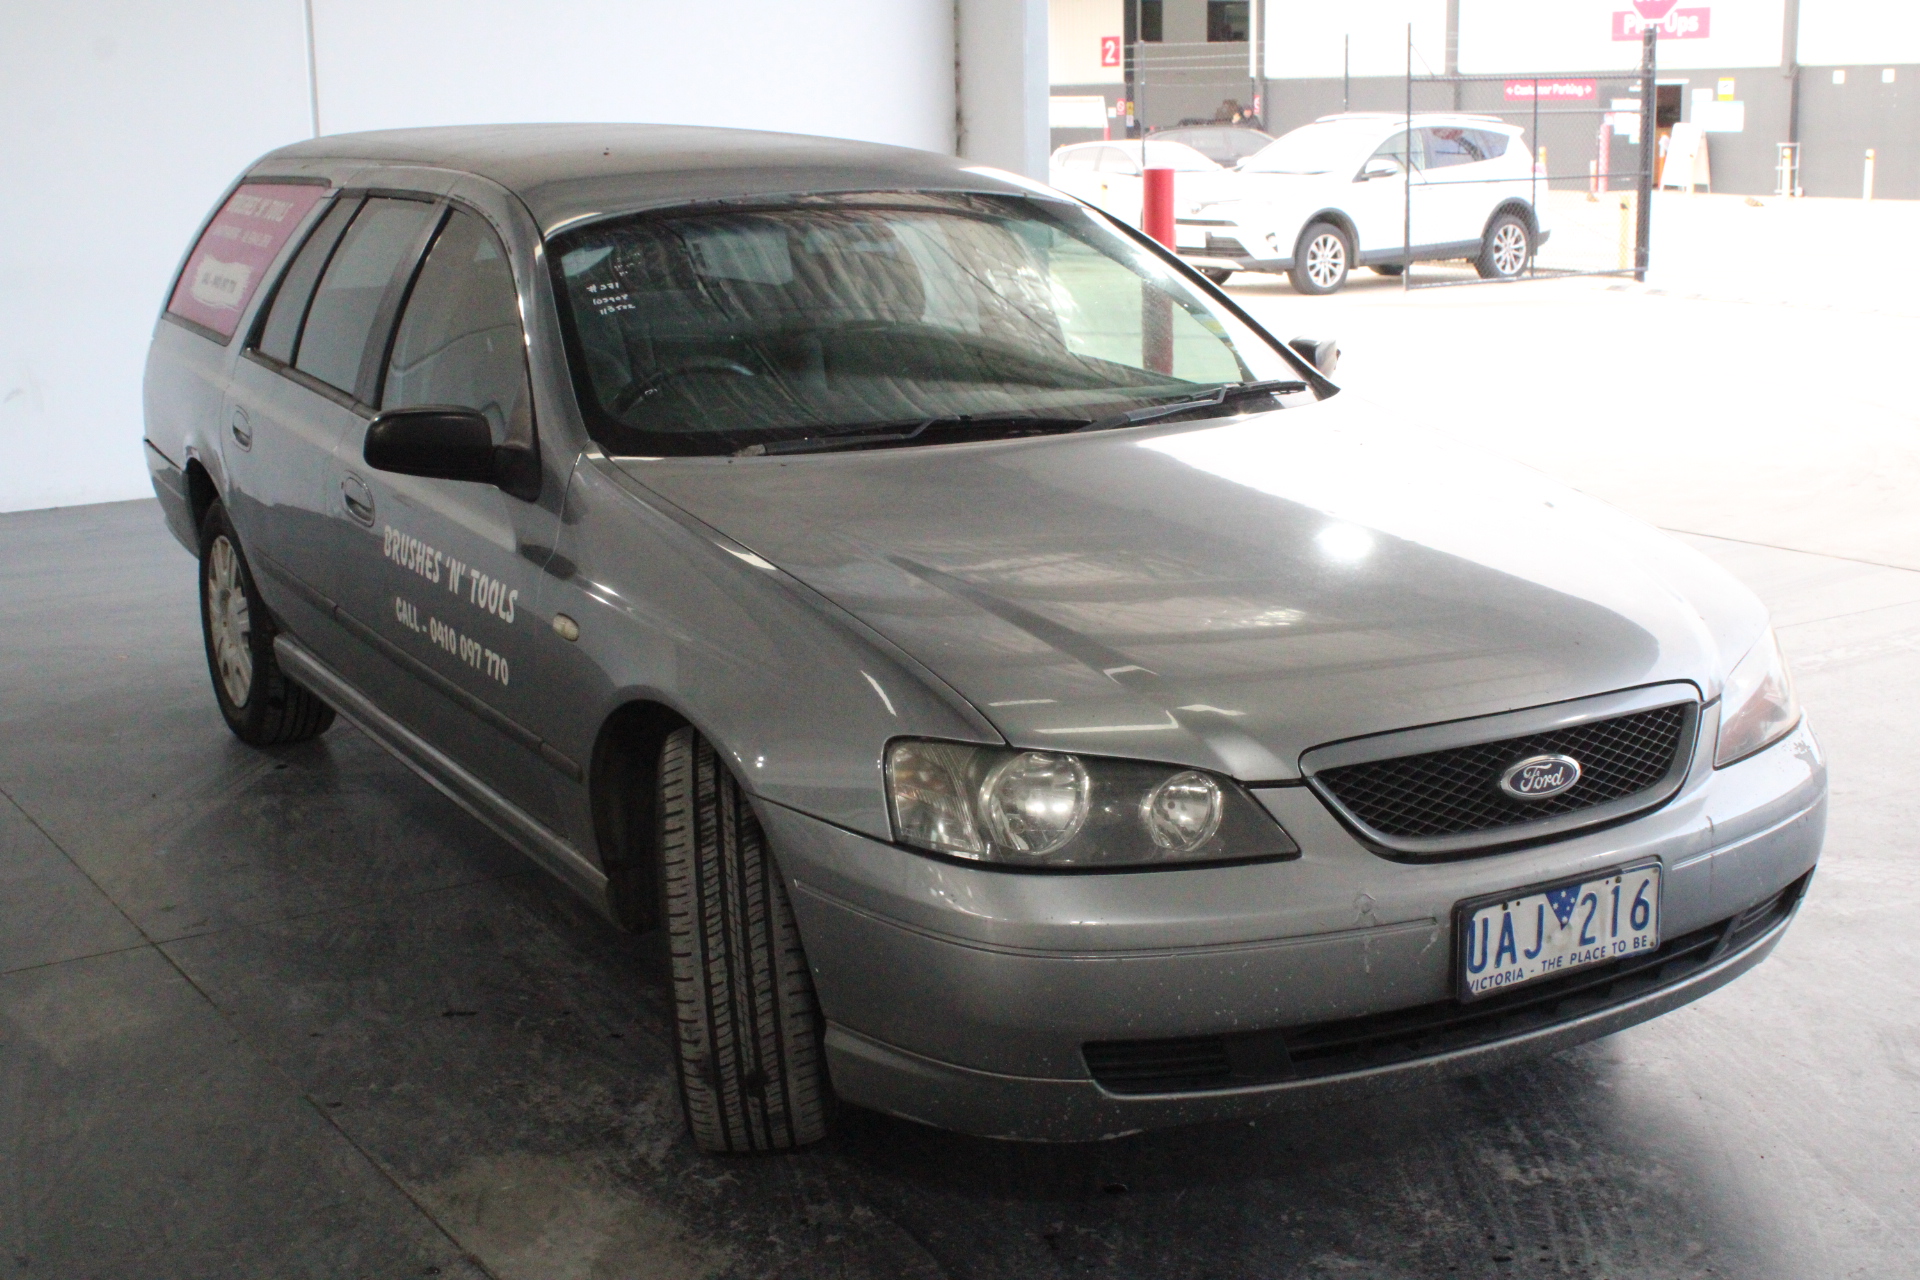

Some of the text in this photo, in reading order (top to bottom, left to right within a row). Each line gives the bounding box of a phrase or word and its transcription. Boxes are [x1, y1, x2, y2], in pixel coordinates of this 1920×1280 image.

[1664, 11, 1699, 37] Ups
[1104, 40, 1116, 64] 2
[1552, 83, 1584, 97] Parking
[384, 525, 518, 623] BRUSHES 'N' TOOLS
[396, 597, 420, 633] CALL
[430, 617, 456, 655] 0410
[460, 634, 481, 669] 097
[485, 649, 509, 686] 770
[1520, 763, 1564, 792] Ford
[1468, 879, 1650, 974] UAJ 216
[1467, 969, 1524, 992] VICTORIA
[1542, 955, 1563, 972] THE
[1570, 945, 1606, 966] PLACE
[1612, 940, 1627, 955] TO
[1633, 934, 1648, 948] BE
